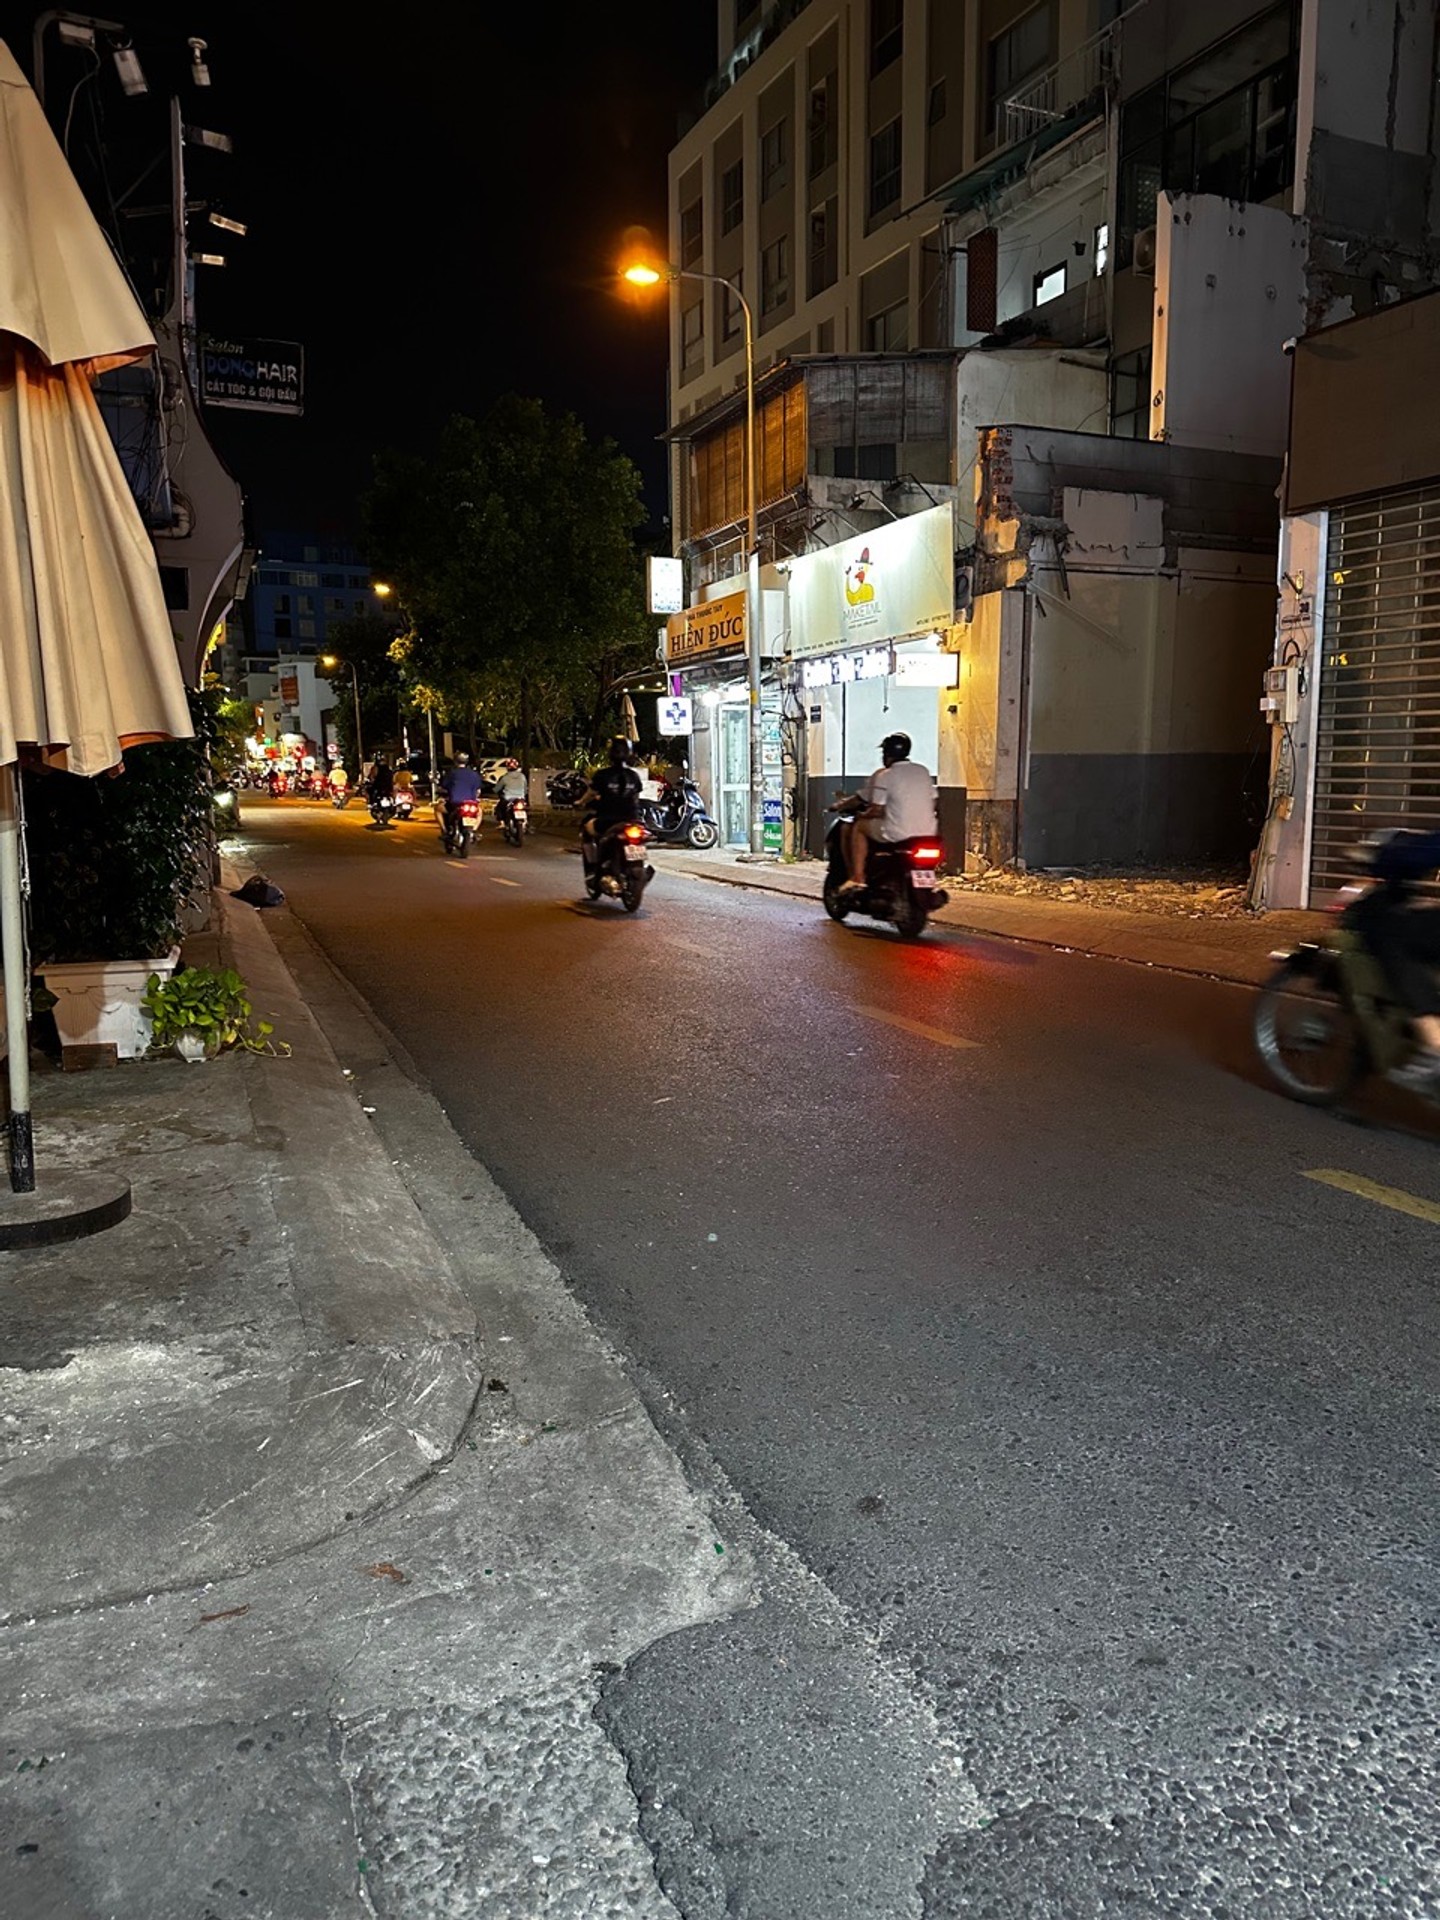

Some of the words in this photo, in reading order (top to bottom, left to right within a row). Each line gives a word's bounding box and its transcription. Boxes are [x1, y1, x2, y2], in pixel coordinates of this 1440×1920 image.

[208, 339, 244, 354] Salon
[248, 385, 257, 396] &
[709, 611, 743, 643] ĐỨC
